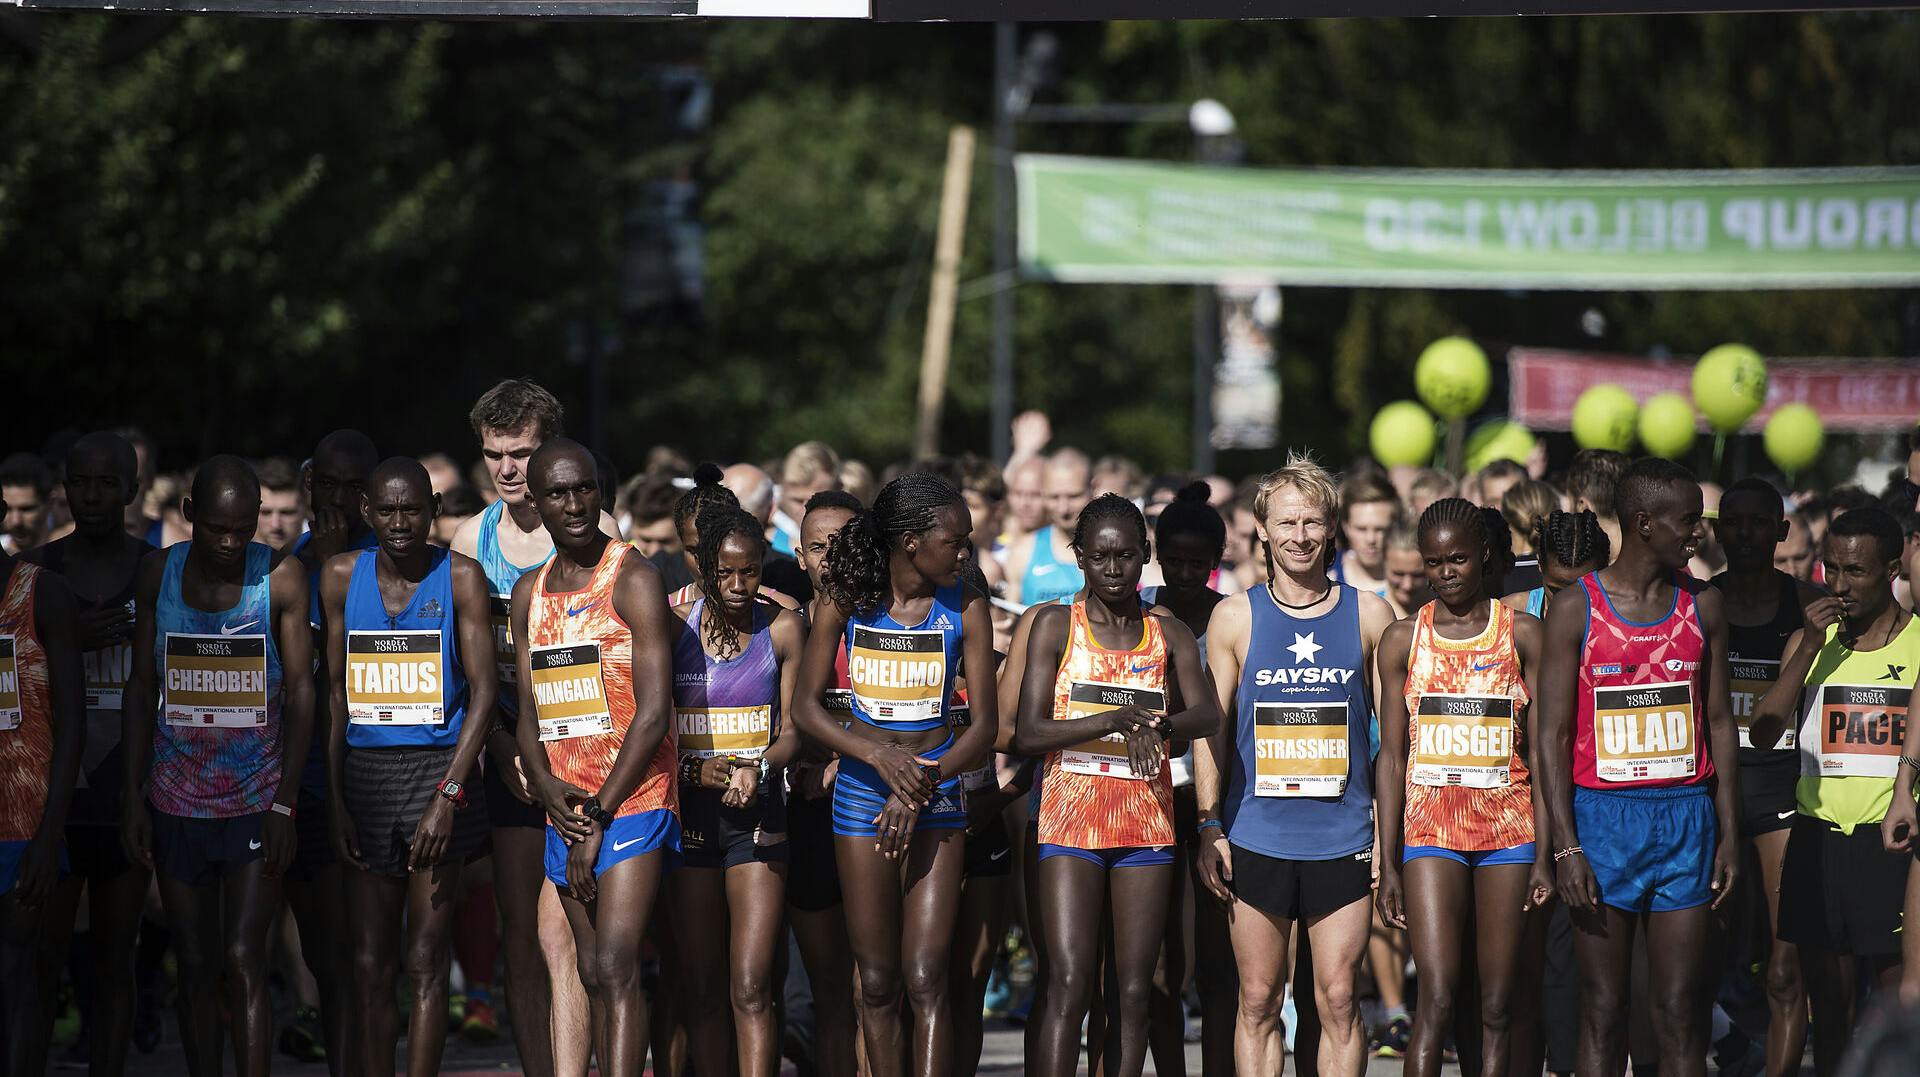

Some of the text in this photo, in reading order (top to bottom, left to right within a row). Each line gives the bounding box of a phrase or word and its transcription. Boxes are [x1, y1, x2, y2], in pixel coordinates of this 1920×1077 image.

[931, 623, 954, 631] adidas
[852, 655, 942, 688] CHELIMO
[1255, 667, 1355, 686] SAYSKY
[167, 668, 264, 693] CHEROBEN
[351, 661, 437, 694] TARUS
[1101, 690, 1133, 700] NORDEA
[1281, 685, 1330, 695] copenhagen
[1850, 691, 1884, 699] NORDEA
[1102, 697, 1135, 706] FONDEN
[1626, 693, 1660, 701] NORDEA
[873, 700, 916, 708] INTERNATIONAL
[1628, 698, 1662, 707] FONDEN
[678, 710, 768, 735] KIBERENGE
[1602, 711, 1688, 755] ULAD
[1828, 710, 1908, 746] PACE
[1420, 723, 1510, 757] KOSGEI
[1257, 738, 1347, 760] STRASSNER
[1091, 755, 1130, 763] INTERNATIONA
[1626, 758, 1670, 766] INTERNATIONAL
[932, 805, 957, 814] adidas
